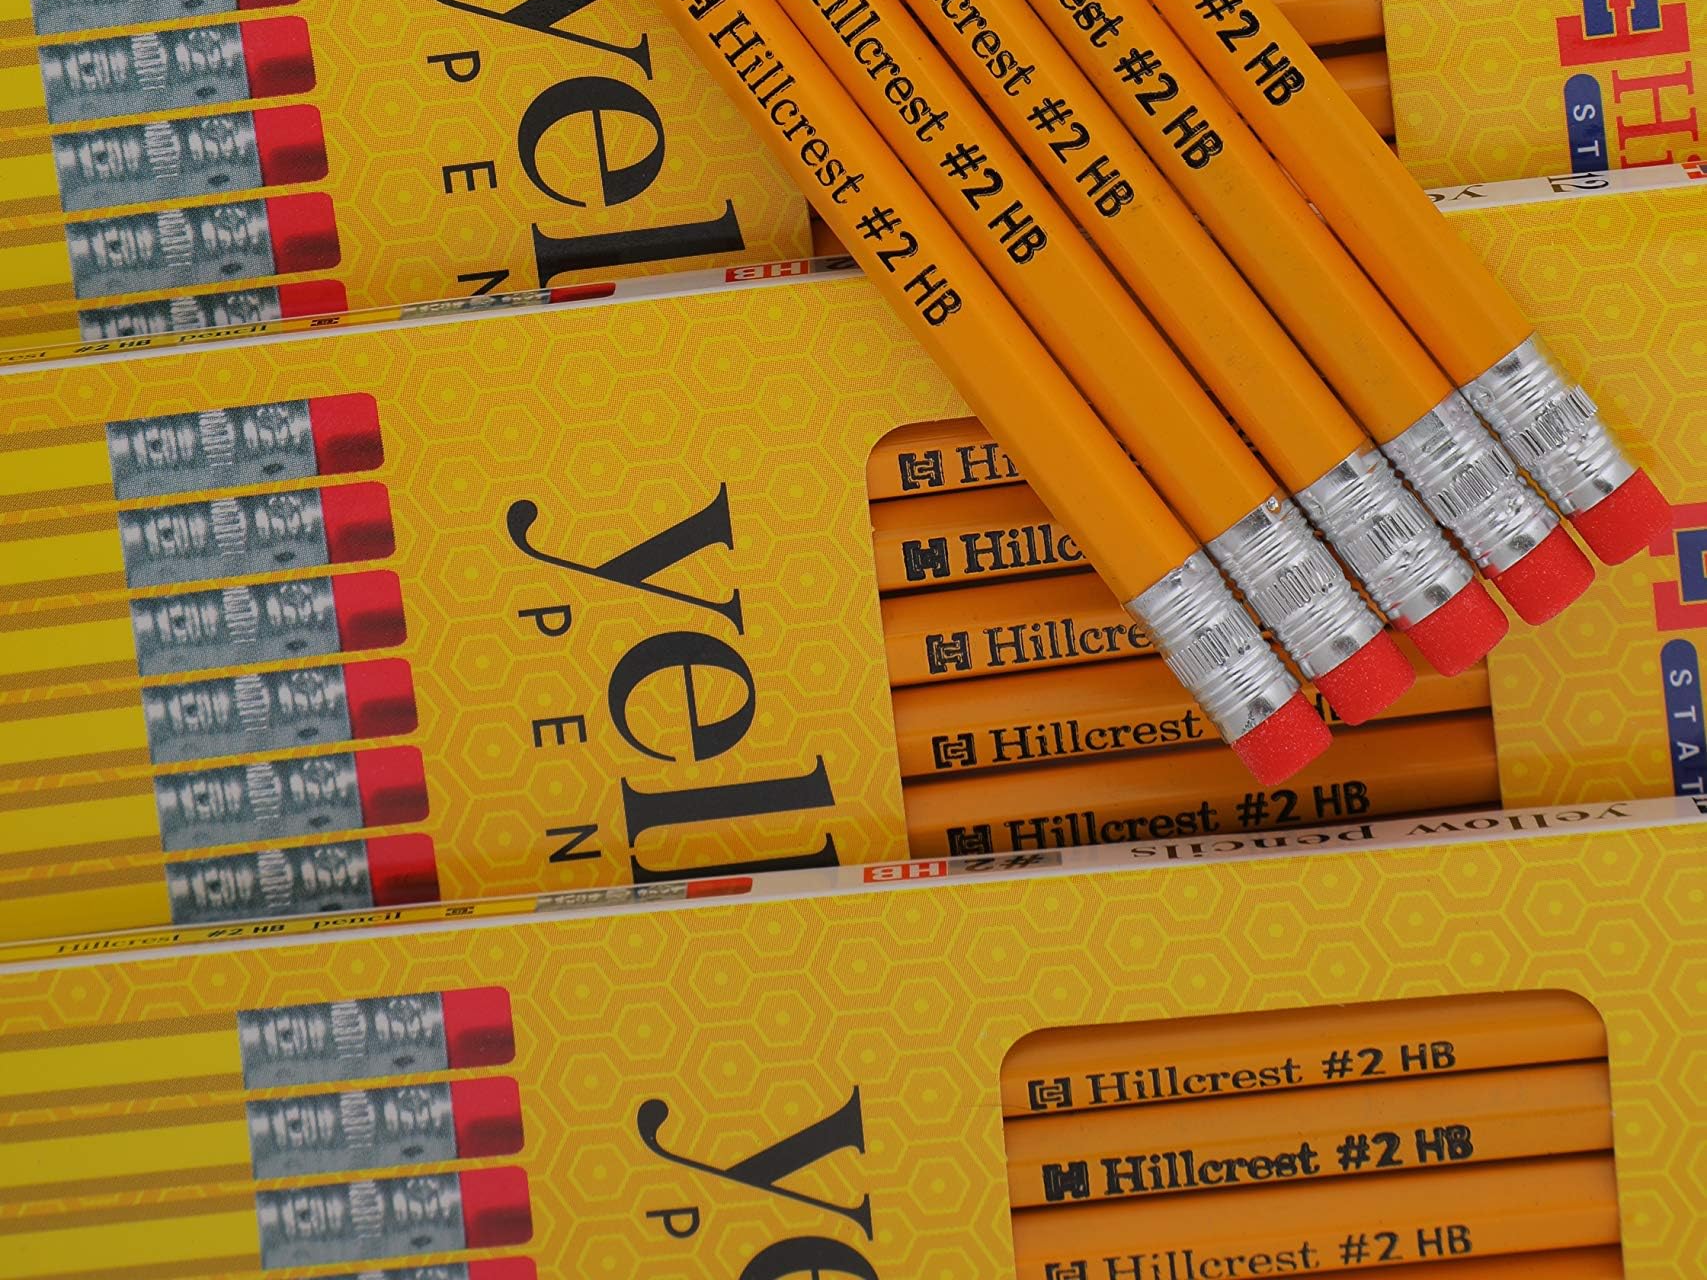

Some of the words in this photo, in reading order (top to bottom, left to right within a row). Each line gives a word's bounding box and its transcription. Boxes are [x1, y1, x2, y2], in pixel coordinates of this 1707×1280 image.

[1114, 46, 1180, 117] #2
[1162, 105, 1224, 170] HB
[1244, 41, 1306, 107] HB
[709, 9, 865, 204] Hillcrest
[856, 203, 918, 273] #2
[904, 263, 963, 327] HB
[1026, 96, 1091, 165] #2
[1075, 154, 1136, 219] HB
[938, 143, 1003, 211] #2
[987, 200, 1048, 265] HB
[990, 709, 1203, 762] Hillcrest
[1004, 800, 1220, 852] Hillcrest
[1237, 789, 1299, 828] #2
[1313, 780, 1370, 817] HB
[872, 860, 940, 881] HB
[1086, 1057, 1302, 1106] Hillcrest
[1322, 1047, 1386, 1080] #2
[1400, 1040, 1456, 1073] HB
[1103, 1141, 1320, 1197] Hillcrest
[1337, 1130, 1404, 1172] #2
[1414, 1124, 1474, 1163] HB
[1103, 1240, 1319, 1280] Hillcrest
[1339, 1231, 1404, 1266] #2
[1417, 1224, 1473, 1258] HB
